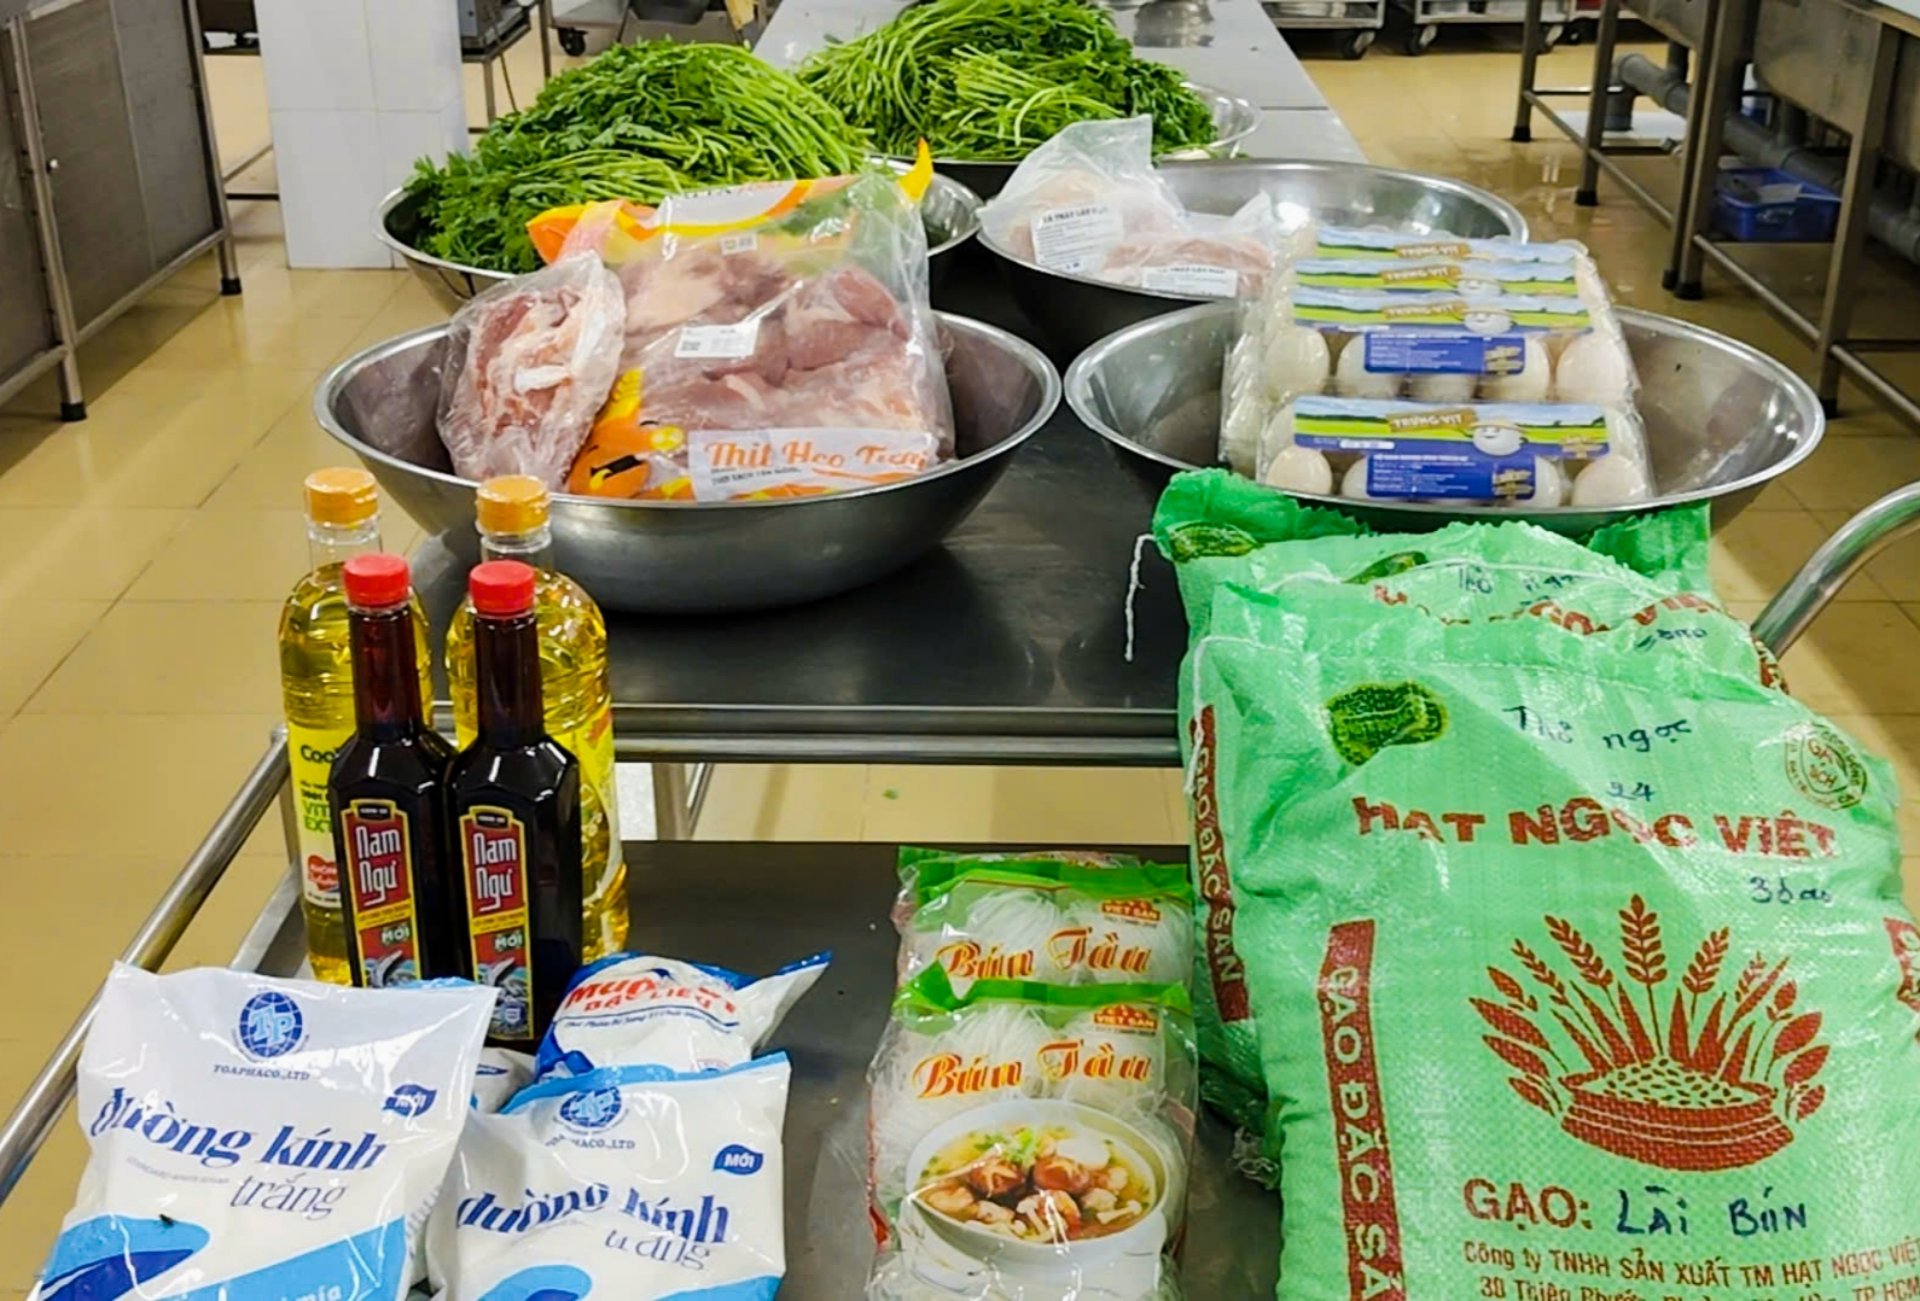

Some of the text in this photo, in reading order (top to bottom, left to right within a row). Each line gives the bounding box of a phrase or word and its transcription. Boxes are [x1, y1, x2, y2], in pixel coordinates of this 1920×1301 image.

[301, 744, 340, 764] Coo
[355, 825, 401, 860] Nam
[473, 832, 517, 866] Nam
[358, 859, 398, 907] Ngư
[475, 866, 513, 913] Ngư
[936, 938, 1034, 979] Bún
[912, 1052, 1022, 1100] Bún
[260, 1125, 386, 1171] kính
[230, 1172, 349, 1221] trắng
[1463, 1179, 1593, 1231] GẠO:
[1463, 1240, 1515, 1271] Công
[1522, 1248, 1541, 1274] ty
[1549, 1249, 1611, 1277] TNHH
[1618, 1247, 1664, 1283] SẢN
[1674, 1256, 1731, 1288] XUẤT
[1739, 1265, 1775, 1288] TM
[1781, 1259, 1822, 1288] HẠT
[1831, 1248, 1884, 1280] NGỌC
